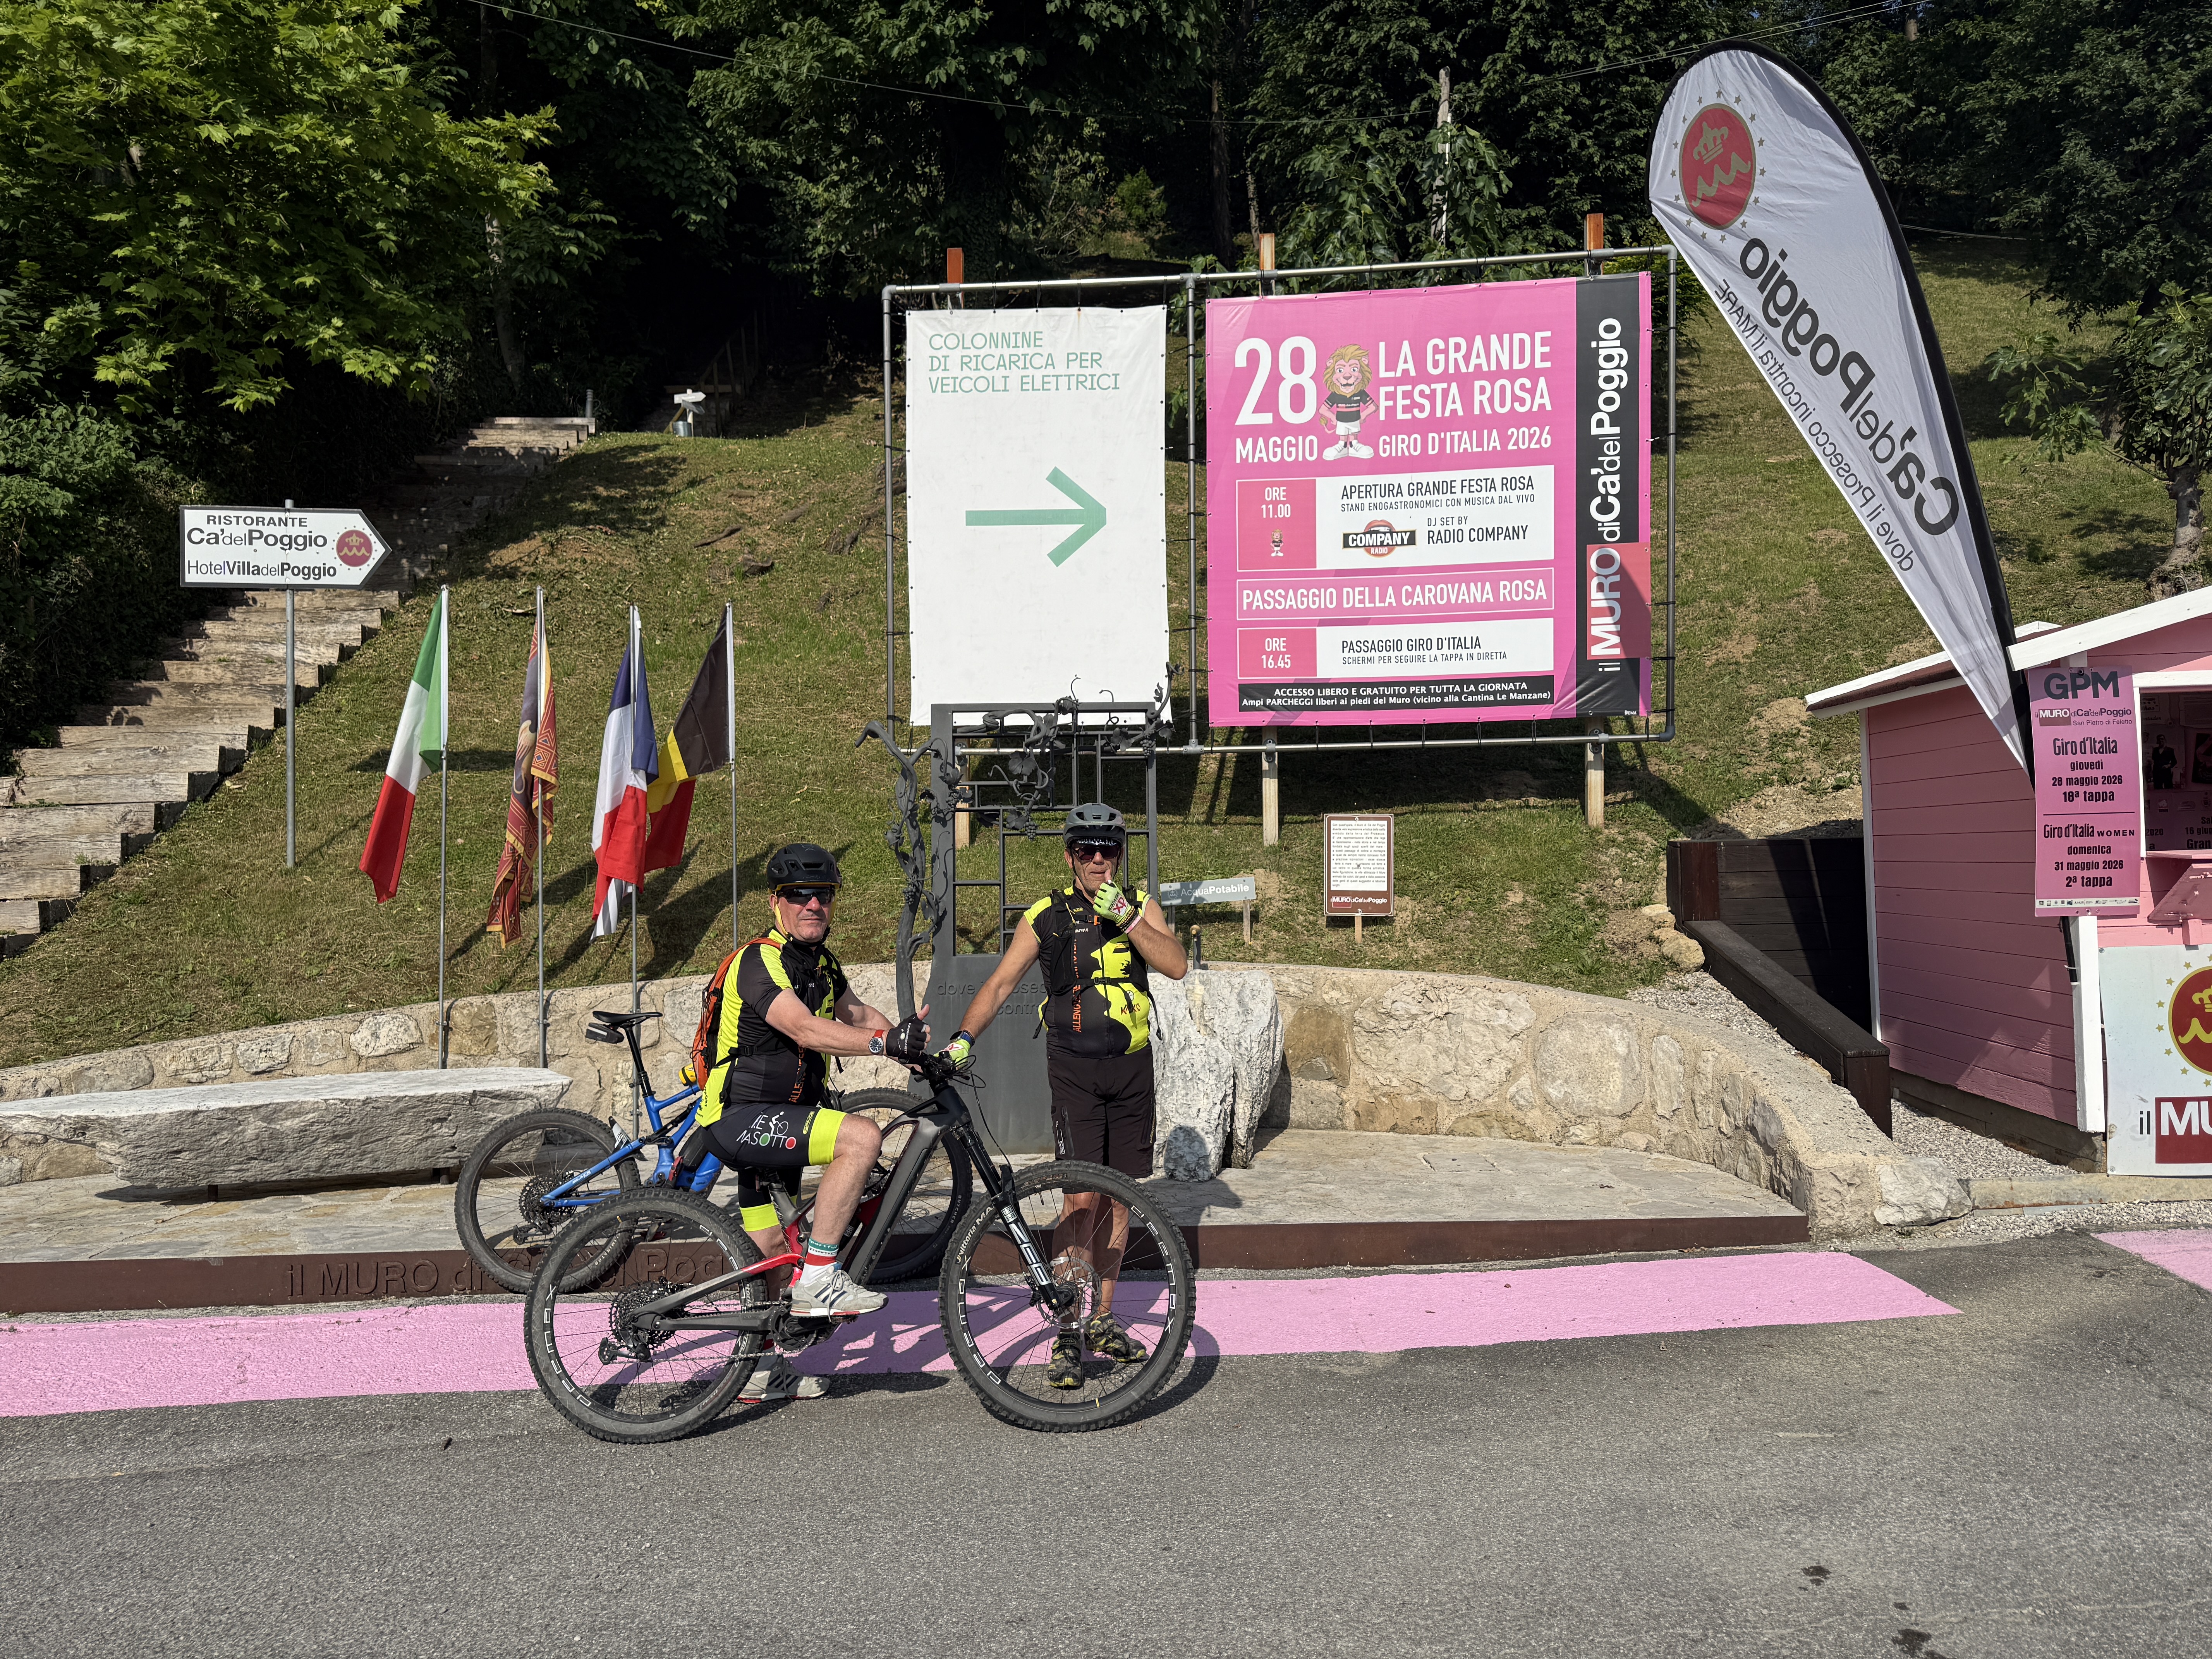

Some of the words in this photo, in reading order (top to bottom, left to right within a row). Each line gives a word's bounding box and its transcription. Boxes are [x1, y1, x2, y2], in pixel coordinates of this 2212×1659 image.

[929, 331, 1043, 350] COLONNINE
[929, 355, 950, 372] DI
[960, 352, 1056, 372] RICARICA
[1066, 352, 1102, 369] PER
[1379, 340, 1416, 378] LA
[1427, 331, 1551, 375] GRANDE
[929, 376, 1010, 393] VEICOLI
[1020, 373, 1120, 392] ELETTRICI
[1235, 336, 1317, 425] 28
[1379, 382, 1464, 421] FESTA
[1474, 376, 1552, 415] ROSA
[1236, 435, 1318, 463] MAGGIO
[1379, 434, 1421, 457] GIRO
[1428, 429, 1501, 455] D'ITALIA
[1507, 426, 1551, 450] 2026
[1265, 487, 1286, 501] ORE
[1341, 483, 1403, 500] APERTURA
[1408, 480, 1456, 496] GRANDE
[1461, 477, 1497, 494] FESTA
[1501, 476, 1534, 492] ROSA
[1261, 503, 1291, 518] 11.00
[1341, 503, 1365, 512] STAND
[1369, 499, 1442, 511] ENOGASTRONOMICI
[1446, 498, 1461, 507] CON
[1465, 496, 1495, 506] MUSICA
[1498, 495, 1513, 504] DAL
[1516, 494, 1535, 503] VIVO
[207, 515, 307, 527] RISTORANTE
[1427, 518, 1436, 527] DJ
[1440, 517, 1455, 526] SET
[1458, 516, 1468, 525] BY
[1348, 532, 1410, 547] COMPANY
[1427, 529, 1464, 544] RADIO
[1468, 525, 1528, 542] COMPANY
[1243, 587, 1336, 610] PASSAGGIO
[1343, 586, 1396, 608] DELLA
[1401, 581, 1494, 606] CAROVANA
[1499, 579, 1547, 601] ROSA
[1265, 638, 1287, 652] ORE
[1342, 639, 1402, 653] PASSAGGIO
[1406, 637, 1433, 652] GIRO
[1437, 636, 1481, 651] D'ITALIA
[1261, 654, 1291, 669] 16.45
[1342, 654, 1375, 665] SCHERMI
[1378, 654, 1392, 664] PER
[1395, 653, 1426, 664] SEGUIRE
[1429, 653, 1438, 662] LA
[1440, 653, 1463, 662] TAPPA
[1467, 652, 1474, 661] IN
[1477, 651, 1507, 661] DIRETTA
[1274, 688, 1315, 696] ACCESSO
[1317, 687, 1348, 696] LIBERO
[1360, 686, 1407, 695] GRATUITO
[1429, 685, 1460, 693] TUTTA
[1463, 684, 1475, 692] LA
[1478, 682, 1528, 692] GIORNATA
[2044, 671, 2119, 700] GPM
[1242, 698, 1263, 707] Ampi
[1266, 698, 1313, 706] PARCHEGGI
[1316, 697, 1337, 706] liberi
[1350, 697, 1370, 706] piedi
[1413, 696, 1441, 704] (vicino
[1462, 694, 1494, 702] Cantina
[1510, 692, 1551, 700] Manzane)
[2039, 709, 2070, 718] MURO
[2053, 738, 2078, 756] Giro
[2080, 736, 2118, 755] d'Italia
[2052, 777, 2063, 786] 28
[2066, 776, 2099, 786] maggio
[2101, 775, 2123, 785] 2026
[2083, 790, 2114, 802] tappa
[2044, 824, 2063, 838] Giro
[2064, 823, 2095, 838] d'Italia
[2068, 845, 2111, 855] domenica
[2187, 839, 2211, 849] Gran
[2054, 861, 2063, 871] 31
[2067, 860, 2099, 871] maggio
[2102, 860, 2124, 869] 2026
[2081, 876, 2112, 888] tappa
[938, 981, 975, 995] dove
[2140, 1111, 2150, 1135] il
[950, 1195, 962, 1223] BUTCHER
[288, 1264, 303, 1297] il
[319, 1259, 438, 1296] MURO
